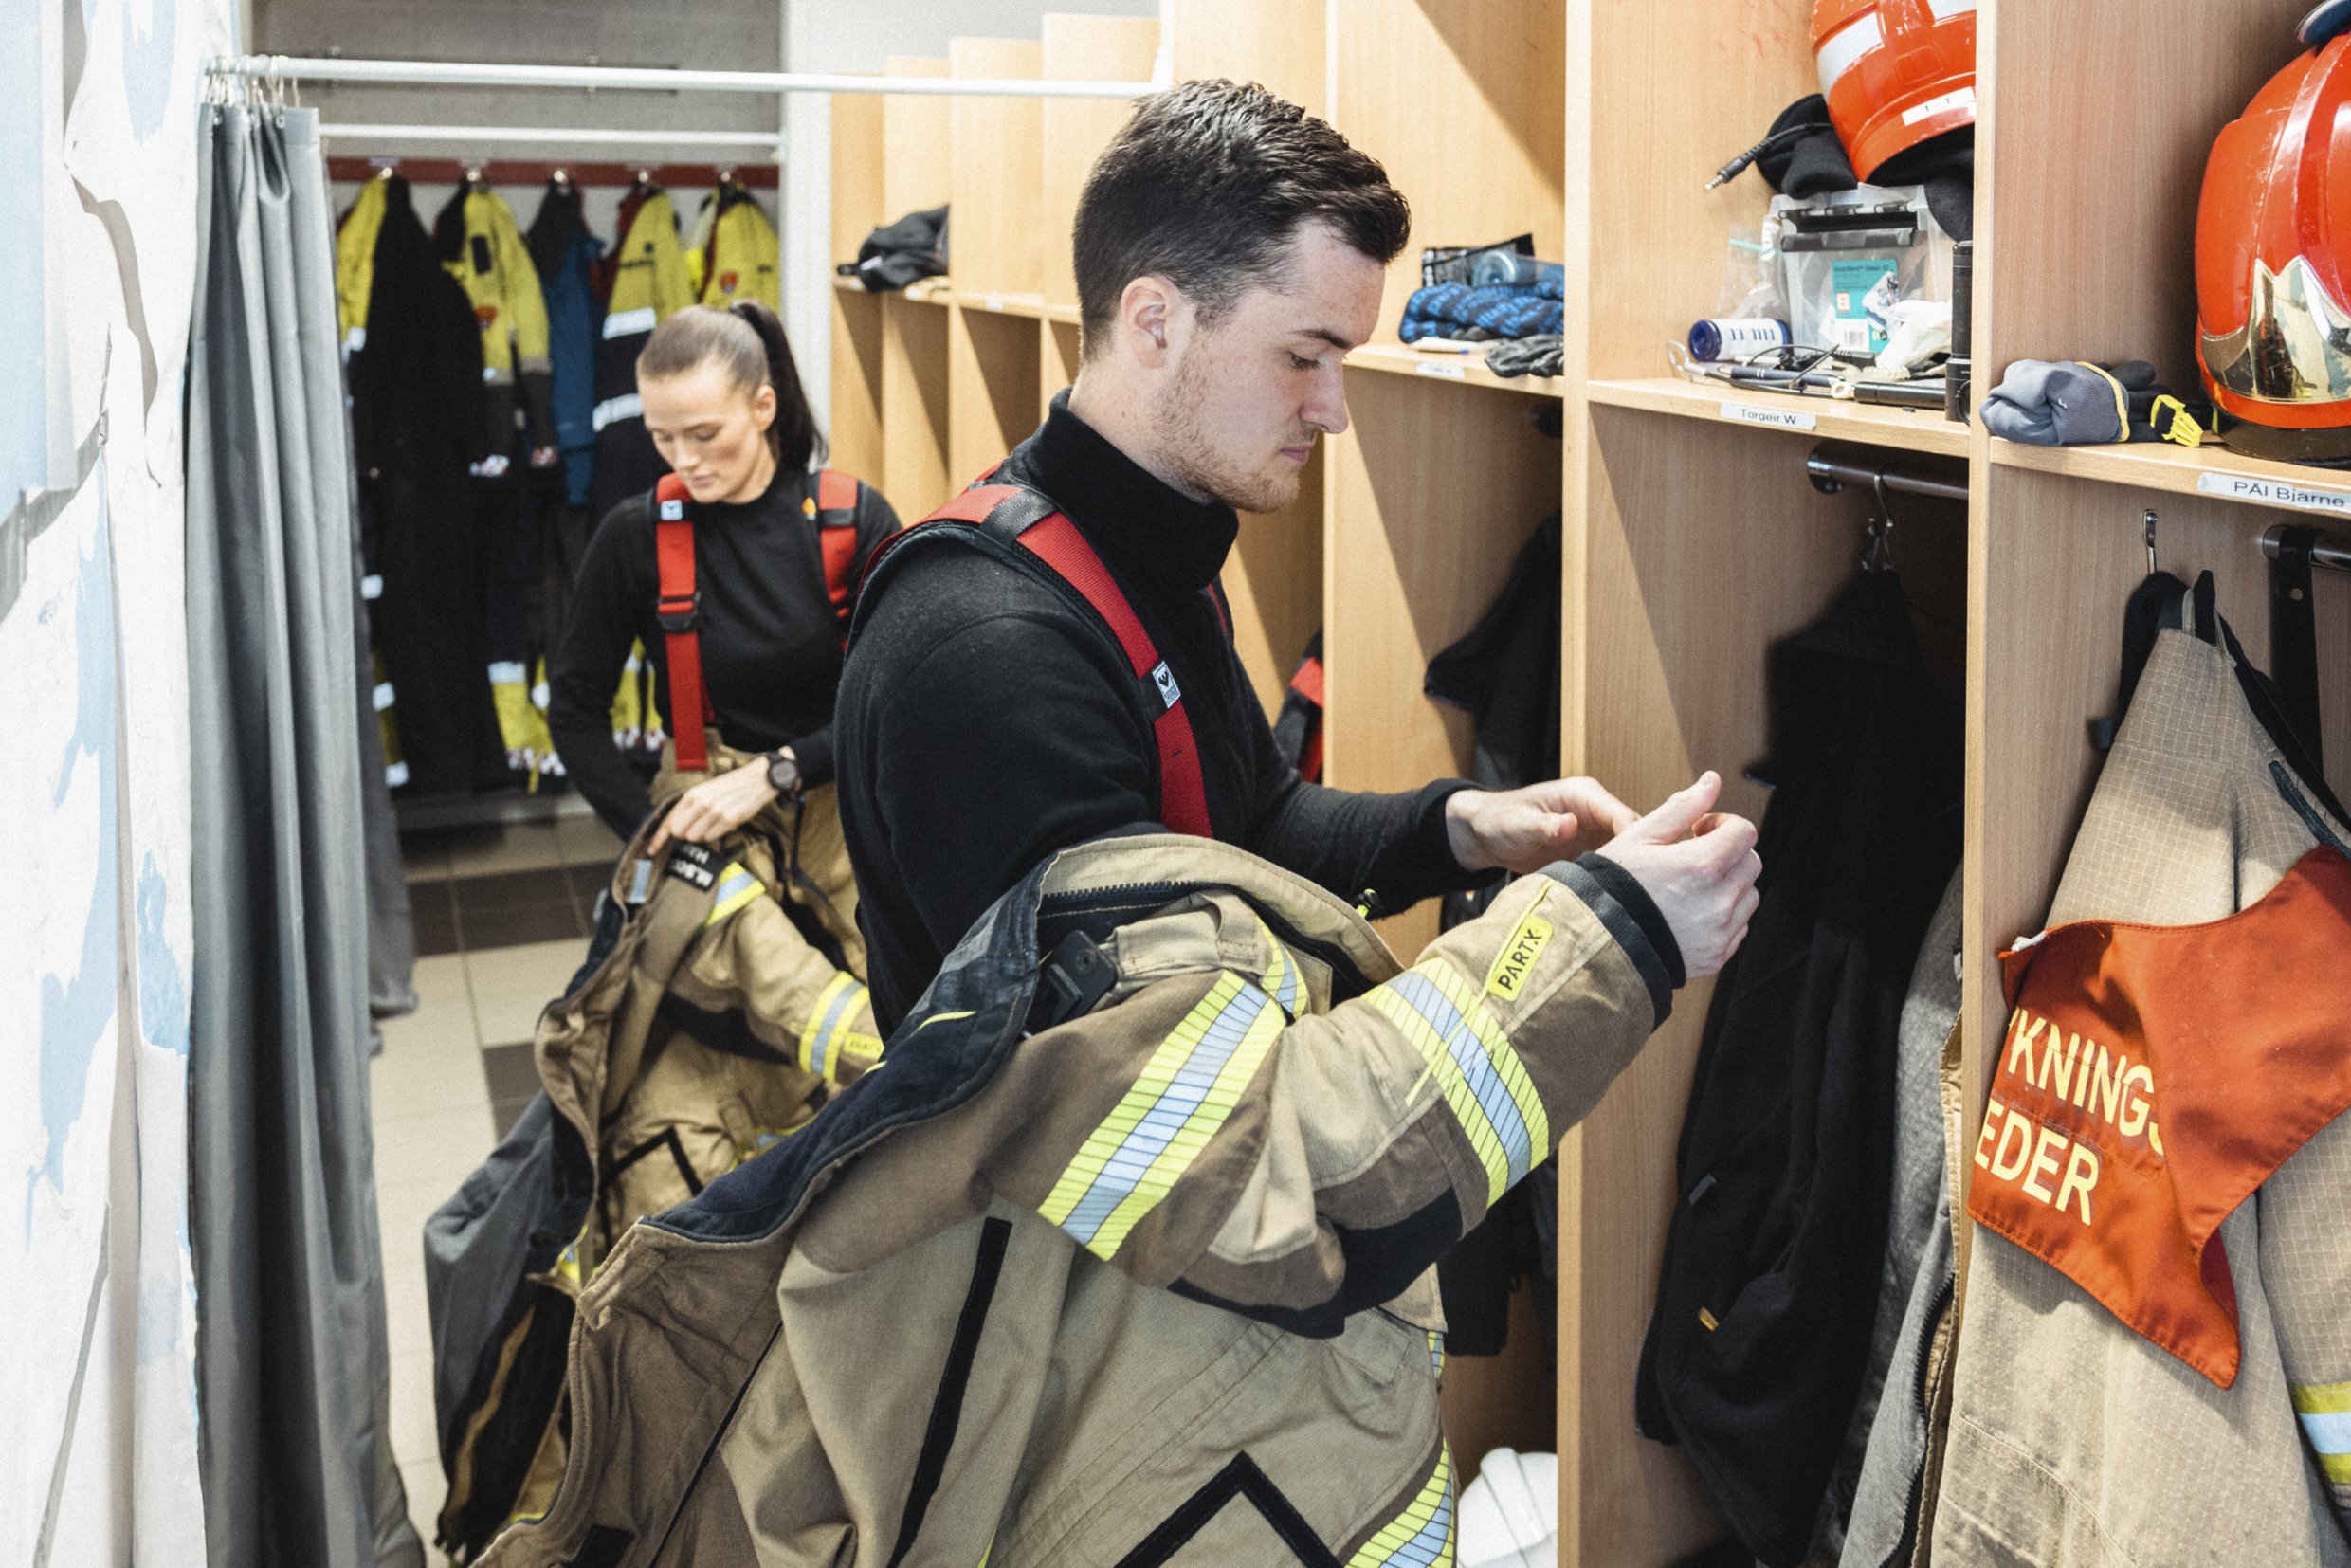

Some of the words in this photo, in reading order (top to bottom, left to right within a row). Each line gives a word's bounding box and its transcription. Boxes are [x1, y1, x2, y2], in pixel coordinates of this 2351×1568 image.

[1740, 408, 1781, 422] Torgeir
[1783, 414, 1797, 425] W
[2277, 487, 2344, 507] Bjarne
[2008, 1006, 2163, 1156] KNING
